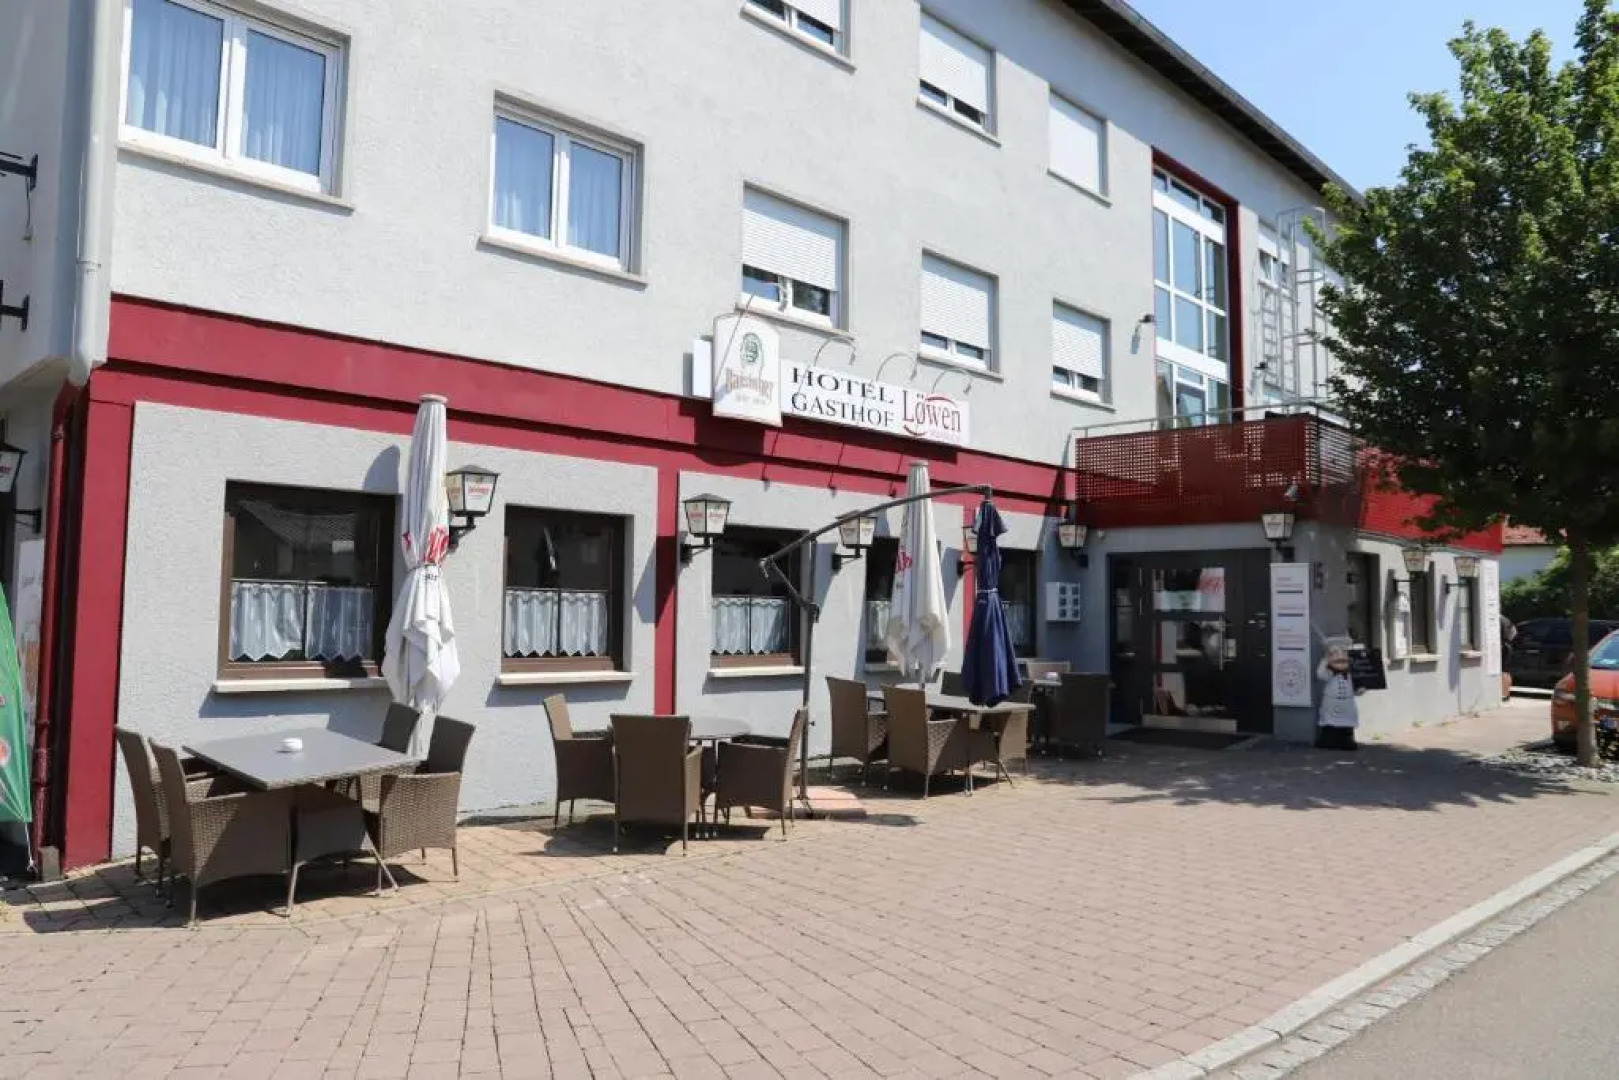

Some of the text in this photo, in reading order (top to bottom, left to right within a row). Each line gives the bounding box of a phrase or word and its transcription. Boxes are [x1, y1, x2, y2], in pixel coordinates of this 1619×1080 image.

[792, 367, 894, 404] HOTEL
[792, 391, 894, 428] GASTHOF
[903, 389, 961, 433] Löwen
